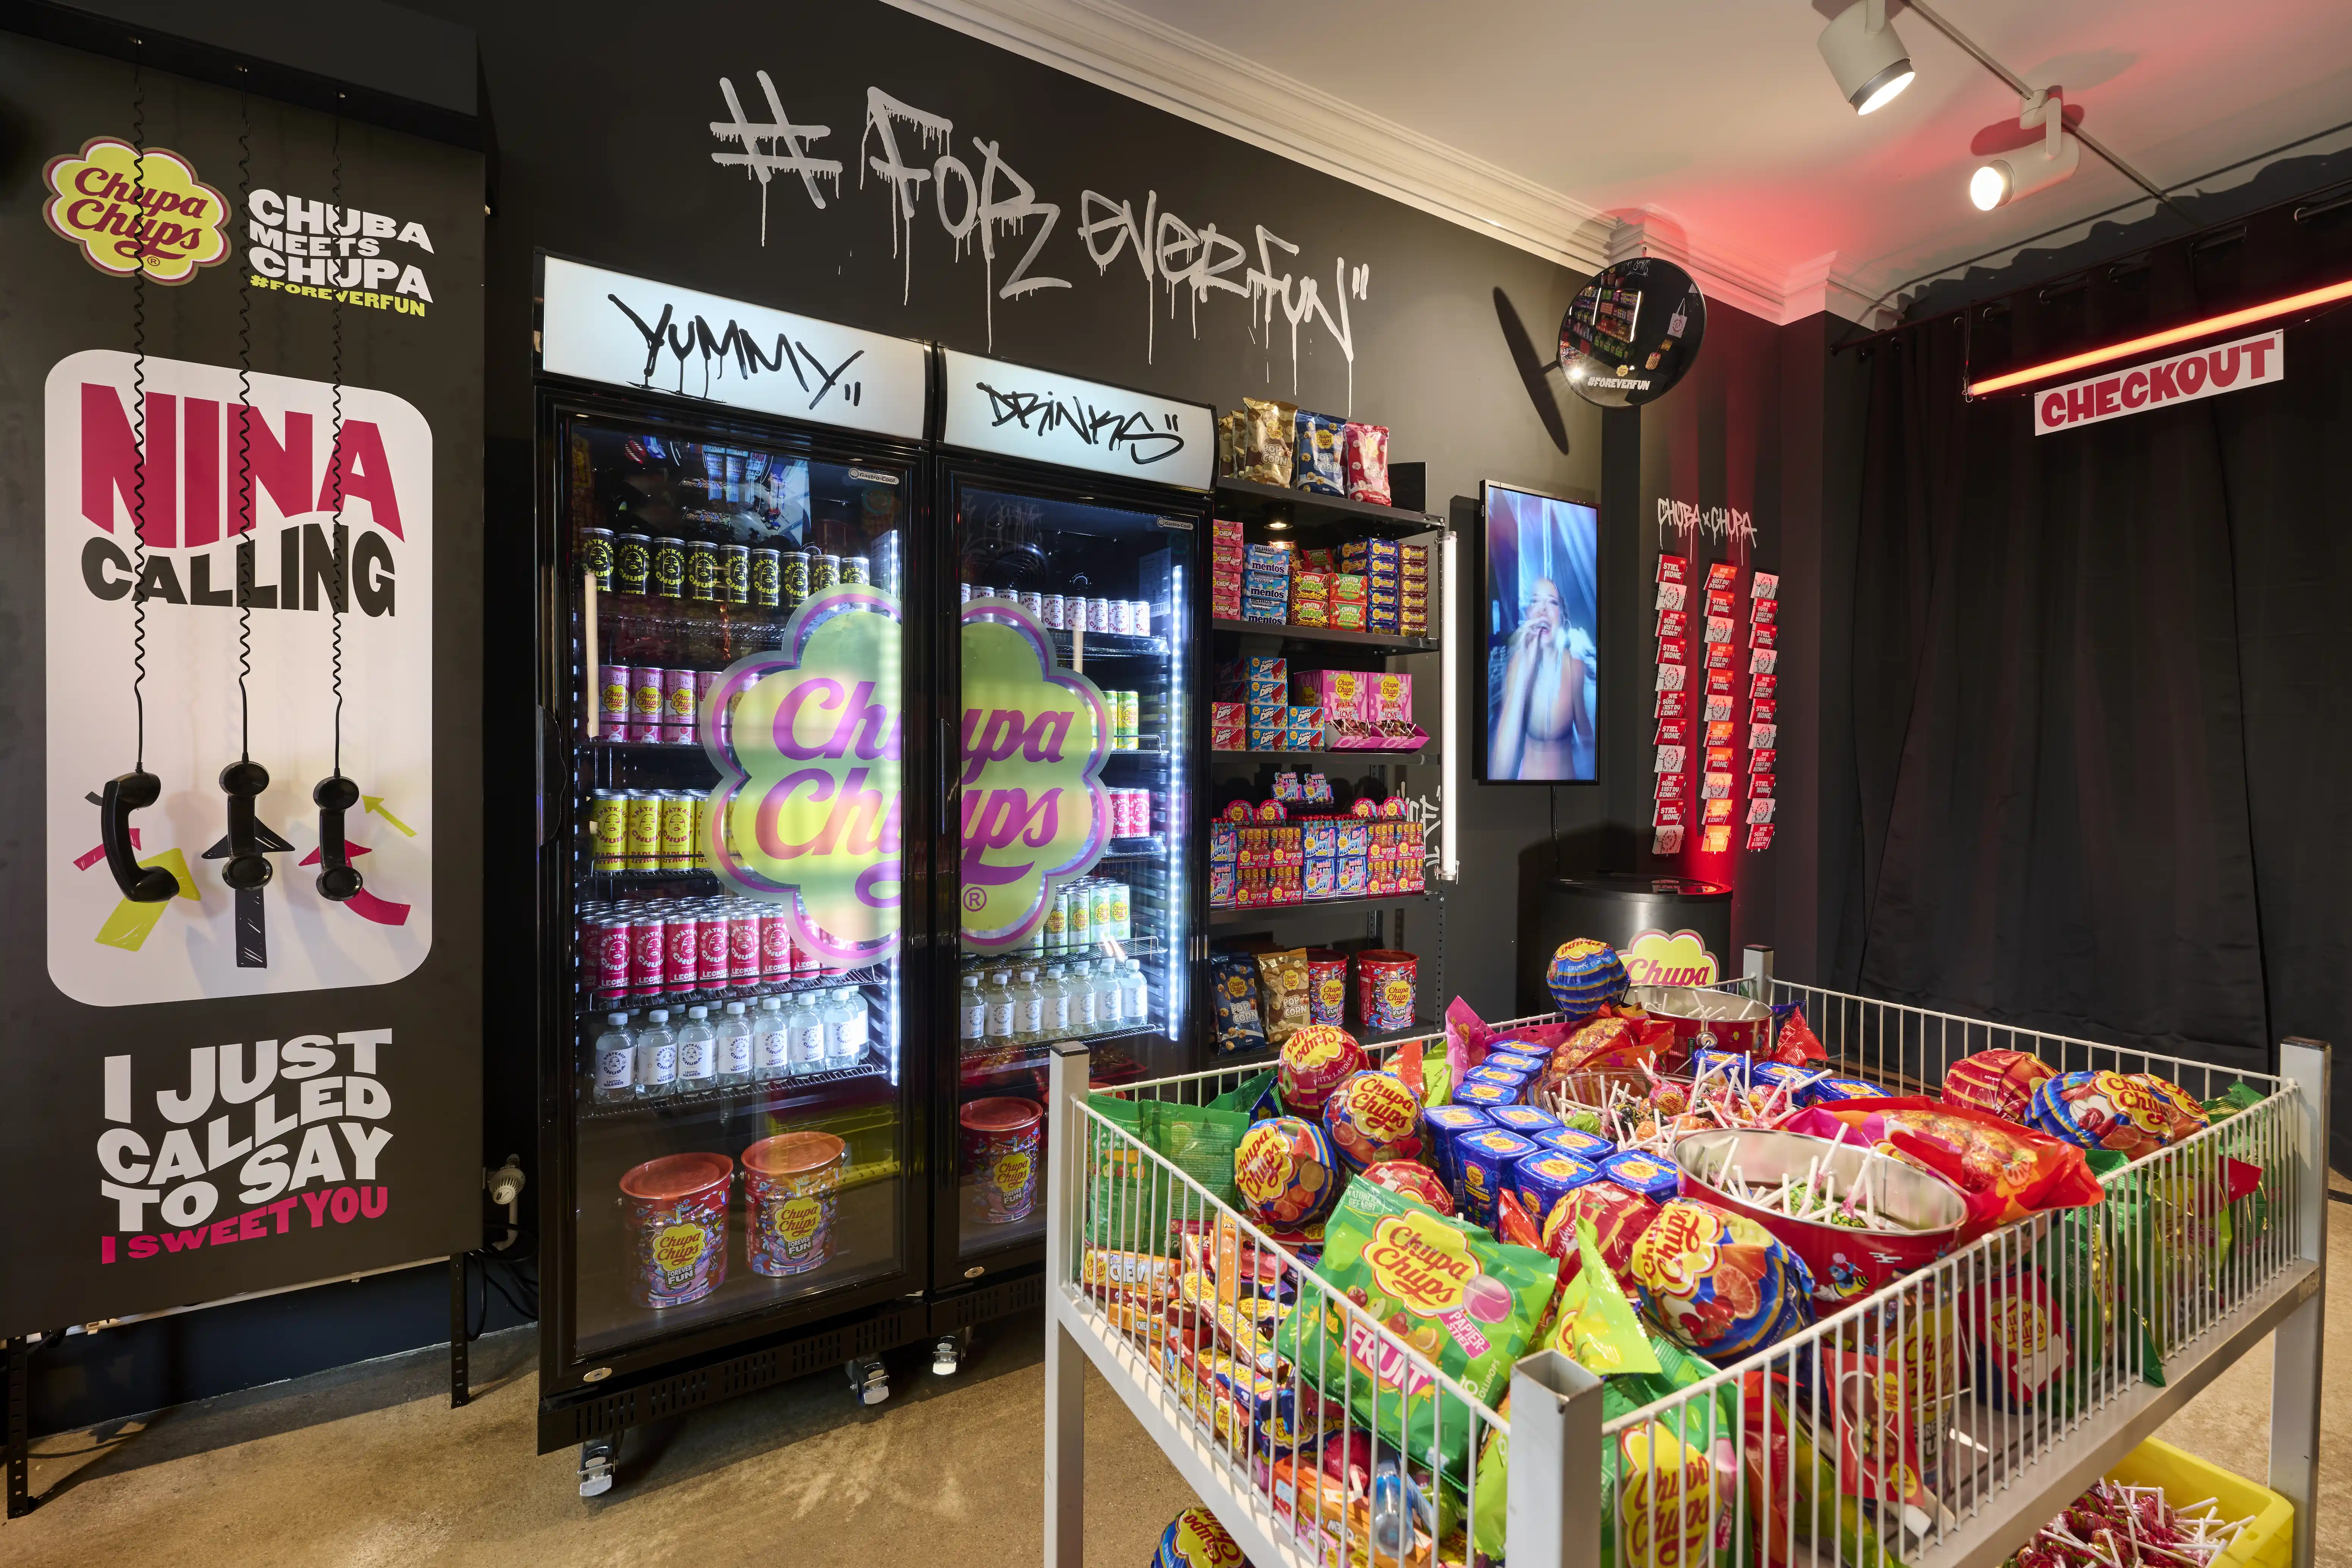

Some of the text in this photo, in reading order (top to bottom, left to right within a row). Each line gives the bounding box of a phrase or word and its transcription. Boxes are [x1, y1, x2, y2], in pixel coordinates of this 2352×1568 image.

[75, 167, 208, 218] Chupa
[248, 189, 434, 254] CHUBA
[67, 199, 201, 259] Chups
[250, 225, 380, 256] MEETS
[249, 247, 433, 303] CHUPA
[251, 275, 425, 317] #FOREVERFUN
[1588, 377, 1650, 390] #FOREVERFUN
[2041, 338, 2275, 427] CHECKOUT
[1262, 443, 1281, 454] POP
[1317, 438, 1332, 446] Chups
[1262, 454, 1287, 466] CORN
[1316, 452, 1332, 463] POP
[81, 382, 405, 548] NINA
[1315, 461, 1340, 473] CORN
[860, 473, 895, 483] Gastro-Cool
[1364, 469, 1384, 480] CORN
[1165, 520, 1191, 529] Gastro-Cool
[1658, 498, 1704, 536] CHUBA
[1711, 507, 1757, 548] CHUPA
[81, 523, 395, 617] CALLING
[1252, 562, 1285, 573] mentos
[689, 575, 718, 588] CHUBA
[1299, 580, 1324, 591] SHOCK
[1338, 580, 1362, 593] SHOCK
[1251, 588, 1284, 599] mentos
[1249, 615, 1282, 624] mentos
[1259, 663, 1274, 673] DIPS
[1337, 686, 1354, 696] Chups
[1383, 688, 1398, 697] Chups
[637, 699, 658, 709] Chups
[1216, 709, 1231, 720] DIPS
[1260, 712, 1274, 721] DIPS
[1297, 712, 1311, 723] DIPS
[1306, 841, 1328, 857] MELODY
[1339, 841, 1359, 856] MELODY
[731, 946, 759, 960] CHUBA
[1628, 958, 1710, 987] Chupa
[1284, 978, 1297, 987] Chups
[1230, 985, 1245, 995] Chups
[1323, 986, 1342, 995] Chupa
[1388, 987, 1408, 995] Chupa
[1283, 995, 1300, 1007] POP
[1322, 991, 1343, 1004] Chups
[1387, 991, 1408, 1004] Chups
[1230, 1001, 1250, 1012] POP
[1284, 1004, 1307, 1017] CORN
[1233, 1010, 1257, 1023] CORN
[603, 1052, 626, 1061] SPÄTKAUF
[105, 1028, 392, 1123] I JUST
[603, 1065, 626, 1075] CHUBA
[1360, 1078, 1414, 1113] Chupa
[1352, 1093, 1410, 1133] Chups
[97, 1076, 391, 1184] CALLED
[1236, 1130, 1270, 1183] Chupa
[999, 1159, 1028, 1174] Chupa
[1246, 1141, 1284, 1200] Chups
[102, 1122, 393, 1231] TO SAY
[997, 1169, 1026, 1188] Chups
[1003, 1188, 1021, 1197] FOREVER
[1004, 1193, 1022, 1204] FUN
[781, 1204, 817, 1221] Chupa
[102, 1186, 387, 1264] I SWEET YOU
[779, 1217, 816, 1237] Chups
[660, 1231, 701, 1249] Chupa
[788, 1236, 811, 1249] FOREVER
[1656, 1206, 1700, 1284] Chups
[788, 1241, 812, 1255] FUN
[1389, 1227, 1471, 1281] Chupa
[657, 1244, 699, 1266] Chups
[667, 1265, 693, 1278] FOREVER
[668, 1271, 693, 1285] FUN
[1373, 1247, 1457, 1306] Chups
[1445, 1322, 1469, 1352] STIEL
[1448, 1311, 1486, 1353] PAPIER-
[1343, 1320, 1429, 1396] FRUIT
